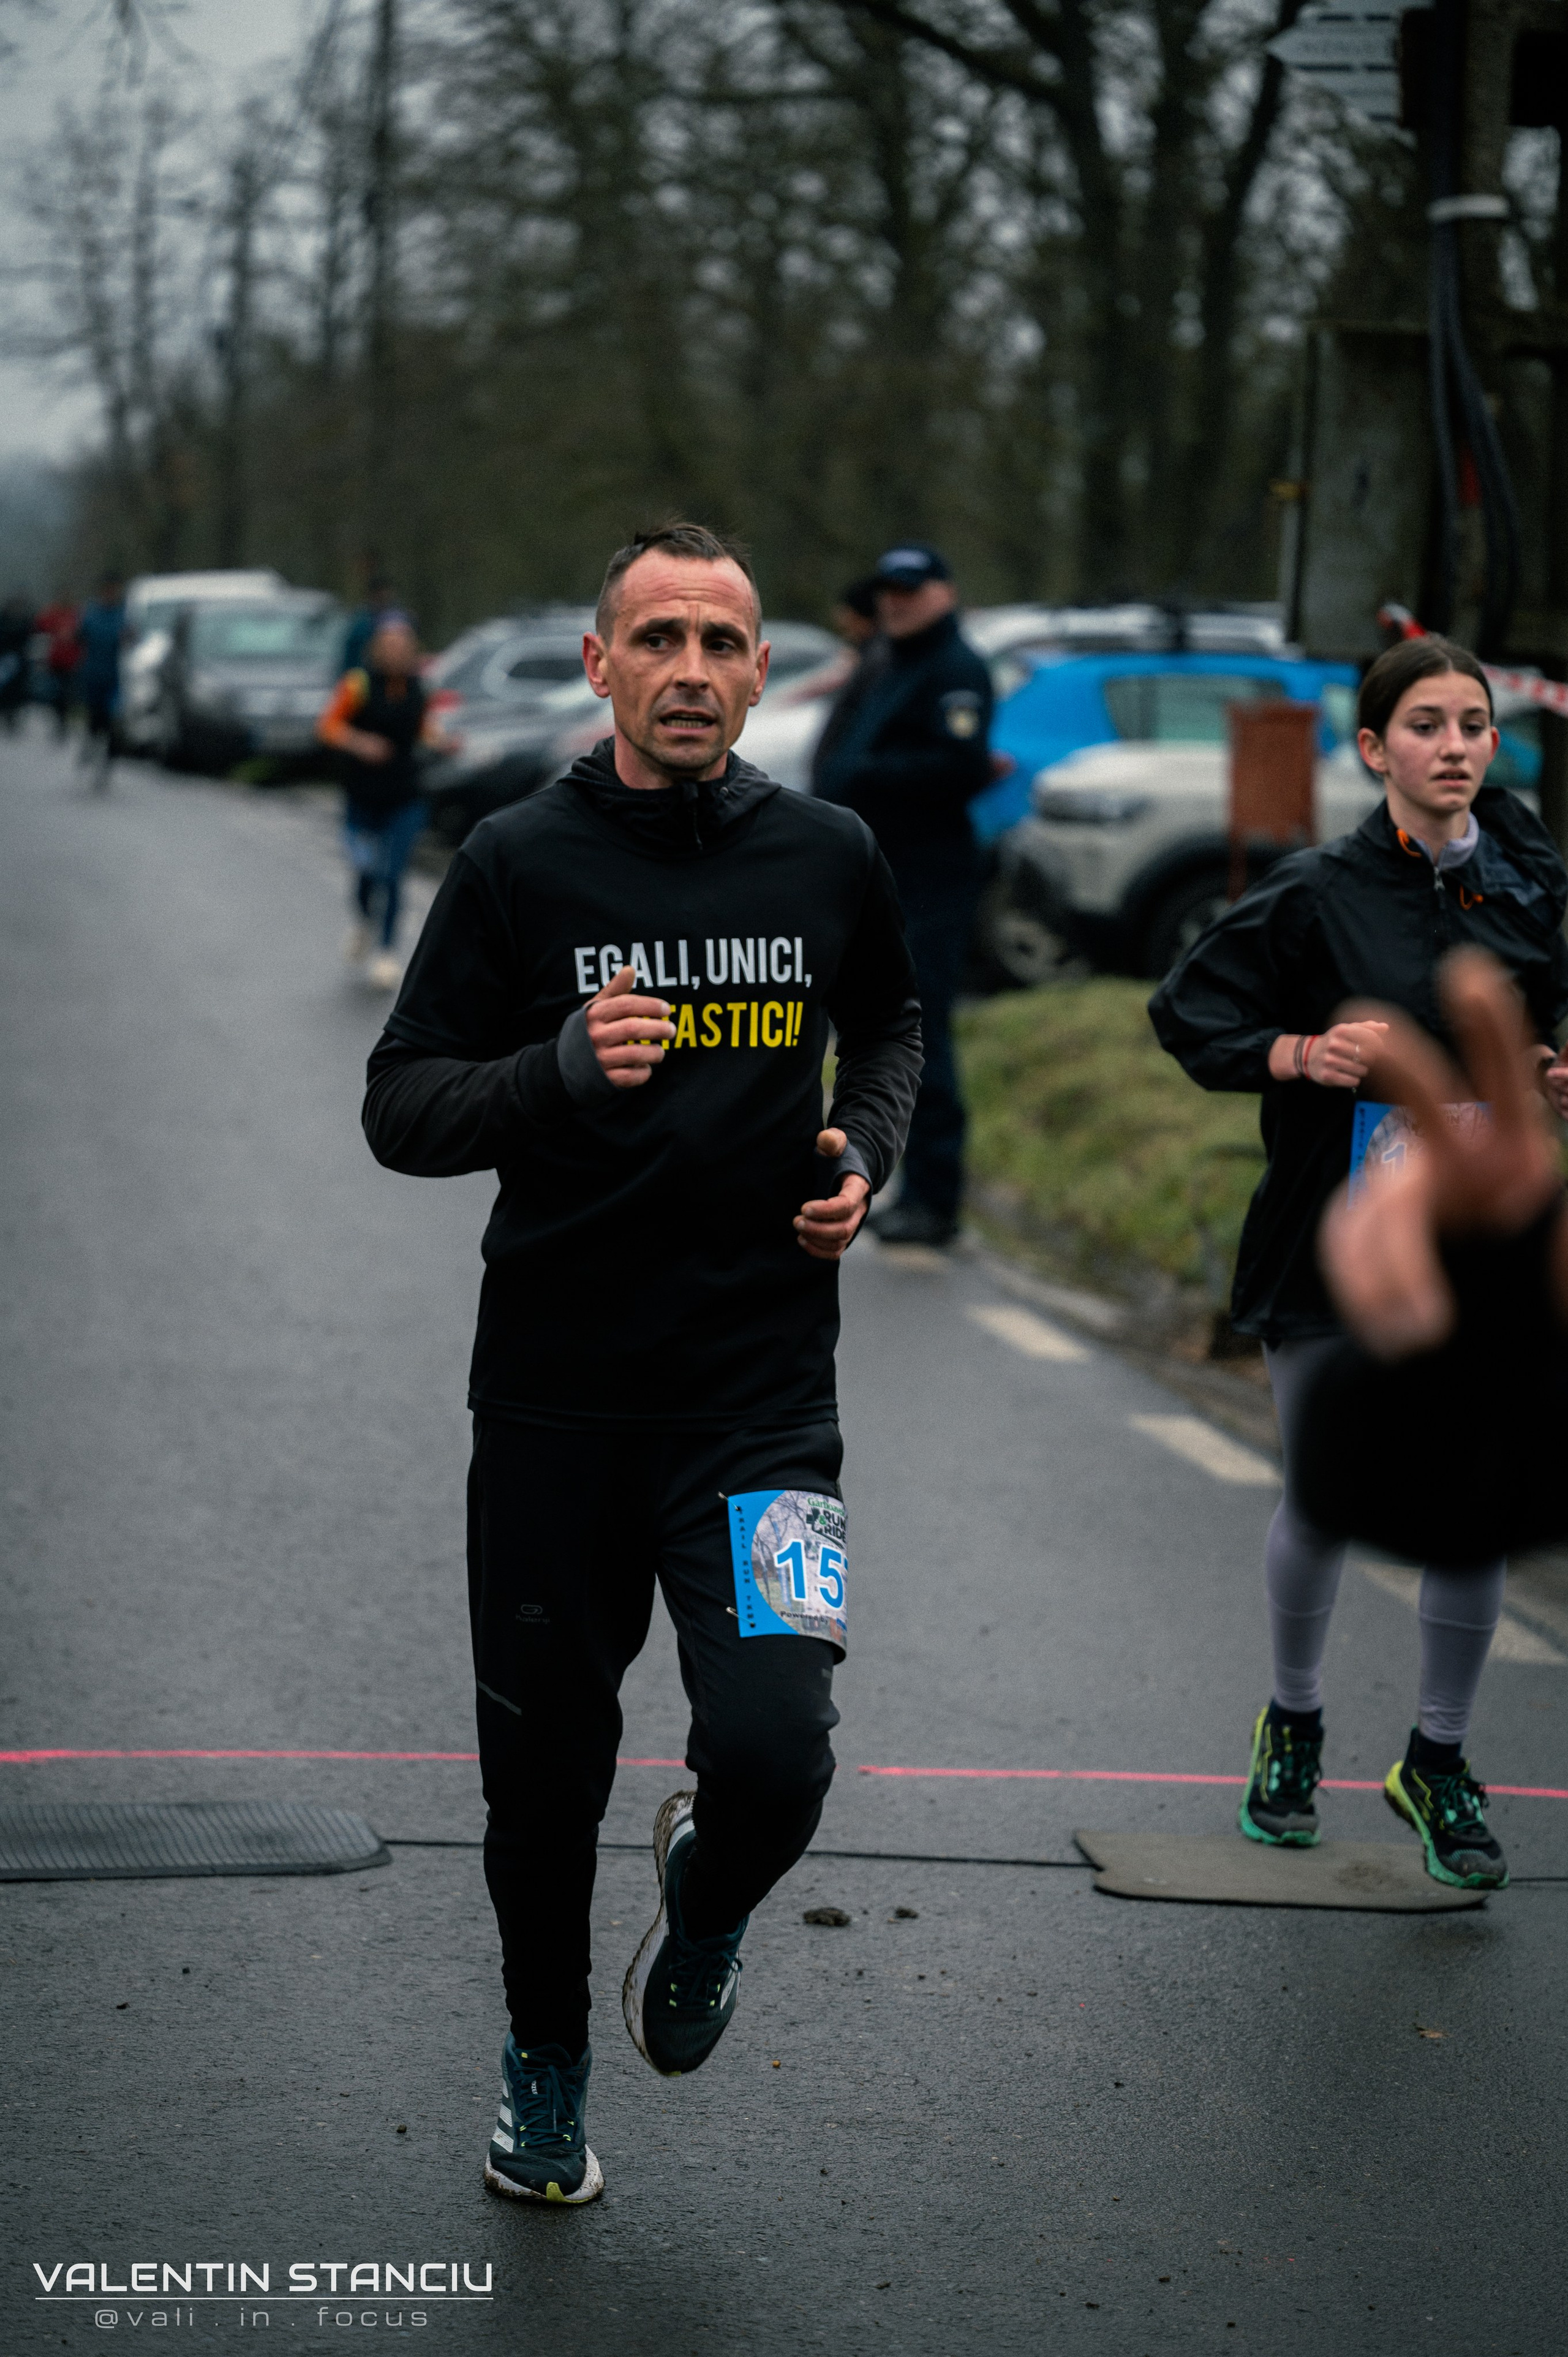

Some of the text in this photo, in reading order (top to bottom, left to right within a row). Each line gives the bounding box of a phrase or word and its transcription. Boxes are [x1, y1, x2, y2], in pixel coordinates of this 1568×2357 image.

[575, 937, 813, 994] EGALI, UNICI,
[823, 1509, 846, 1531] RUN
[824, 1526, 846, 1543] RIDE
[775, 1539, 848, 1610] 15
[780, 1610, 828, 1624] Powered by
